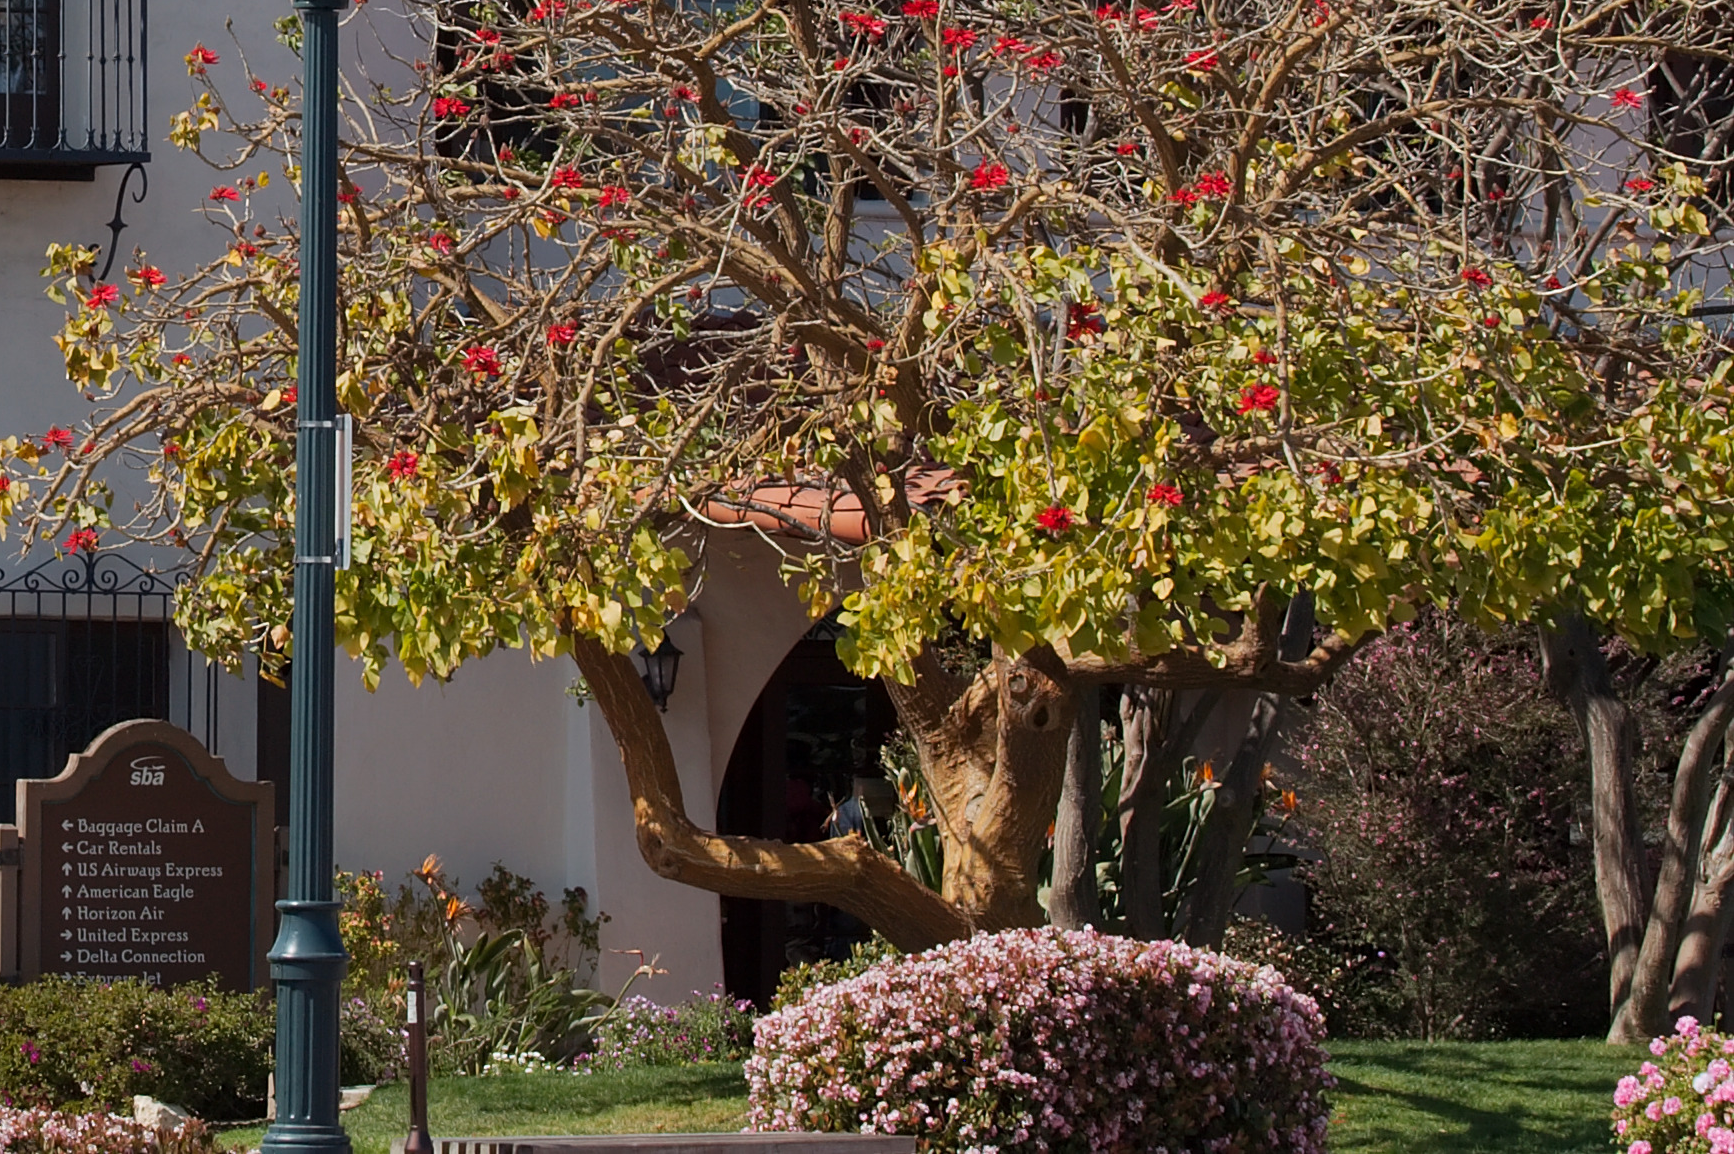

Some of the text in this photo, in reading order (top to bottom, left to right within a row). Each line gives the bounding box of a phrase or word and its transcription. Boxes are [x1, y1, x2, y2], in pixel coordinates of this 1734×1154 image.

[130, 766, 165, 786] sba
[77, 818, 205, 837] Baggage Claim A
[76, 840, 162, 855] Car Rentals
[77, 862, 223, 880] US Airways Express
[76, 883, 194, 902] American Eagle
[76, 905, 165, 920] Horizon Air
[76, 927, 189, 944] United Express
[76, 948, 206, 963] Delta Connection
[138, 970, 162, 985] Jet
